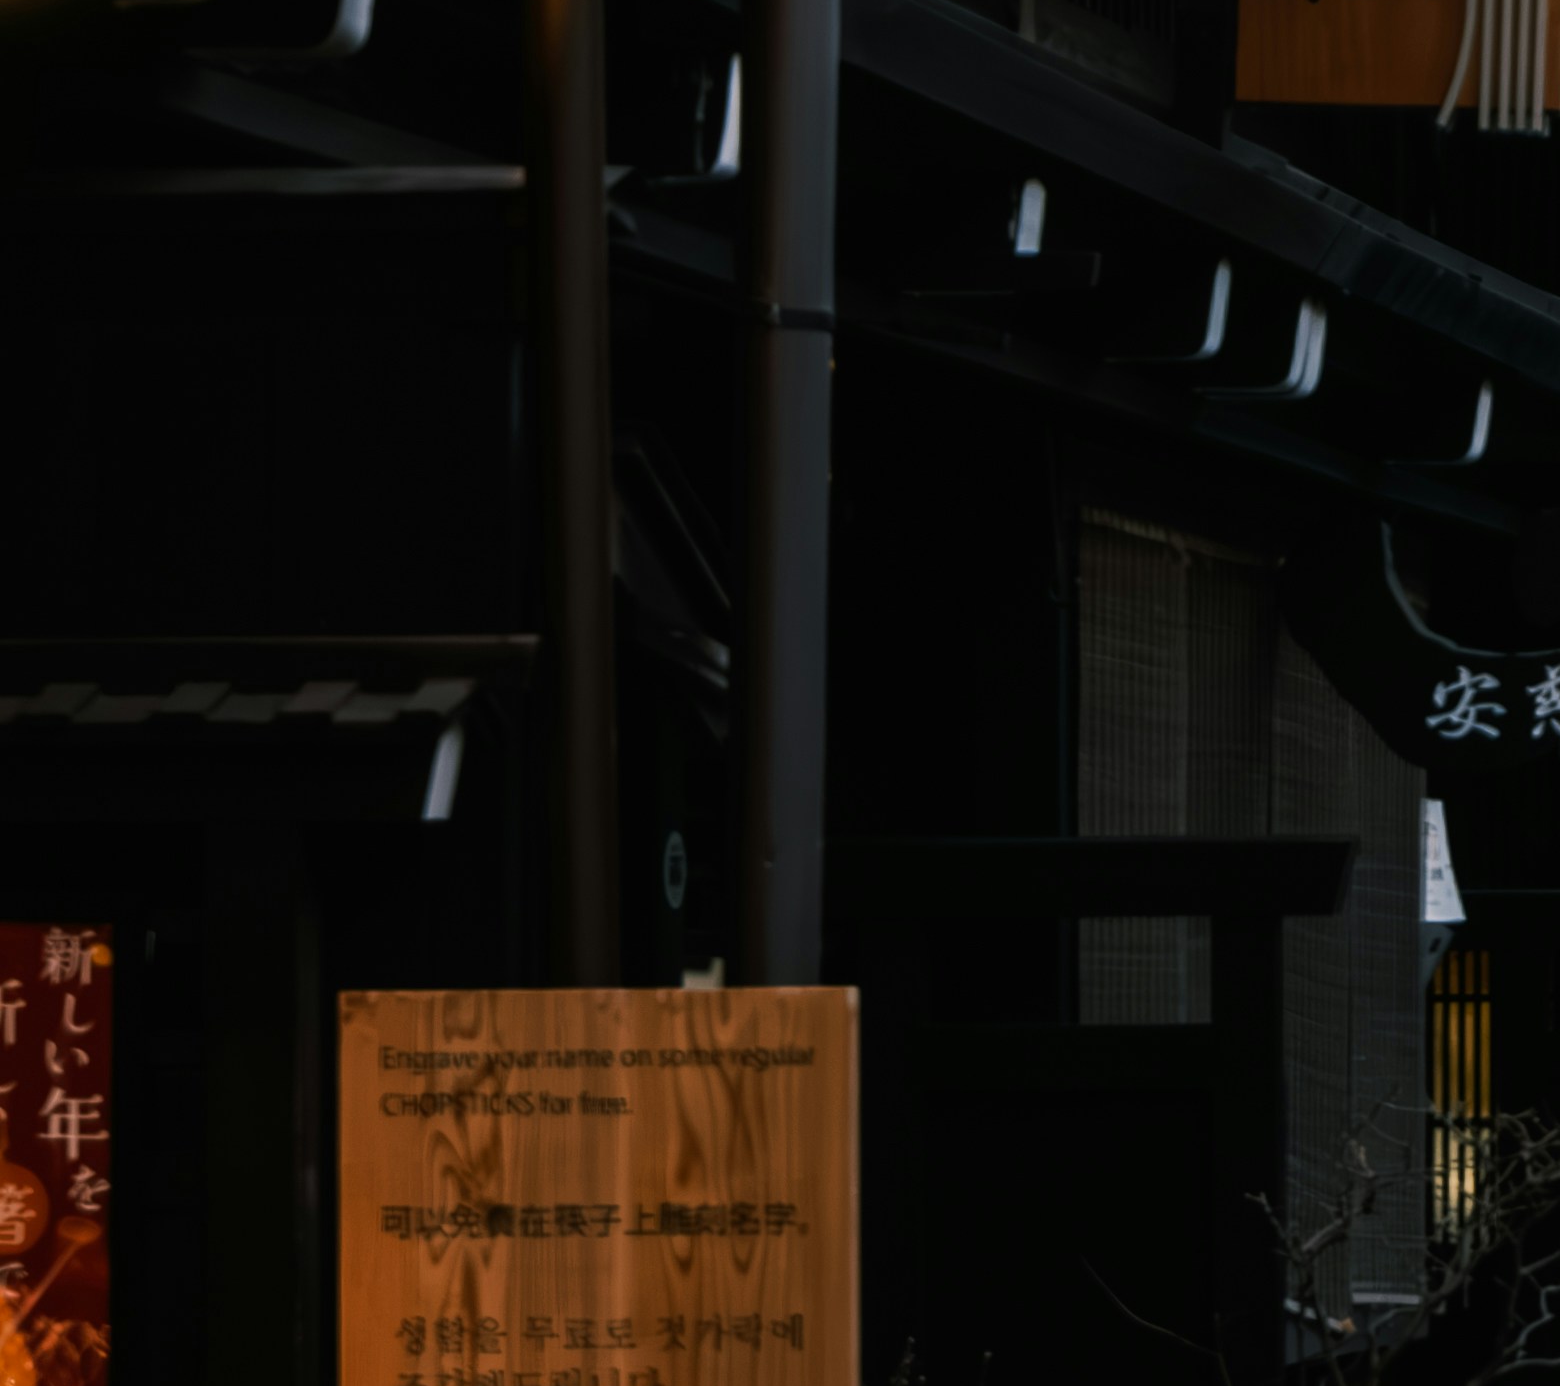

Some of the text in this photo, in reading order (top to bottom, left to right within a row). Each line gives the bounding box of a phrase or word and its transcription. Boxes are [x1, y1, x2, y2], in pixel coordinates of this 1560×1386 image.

[37, 926, 112, 1213] 新しい年を
[380, 1046, 478, 1074] Engrave
[485, 1049, 538, 1074] your
[545, 1049, 613, 1068] name
[620, 1049, 652, 1067] on
[659, 1049, 723, 1067] some
[381, 1093, 535, 1116] CHOPSTICKS
[540, 1092, 571, 1115] for
